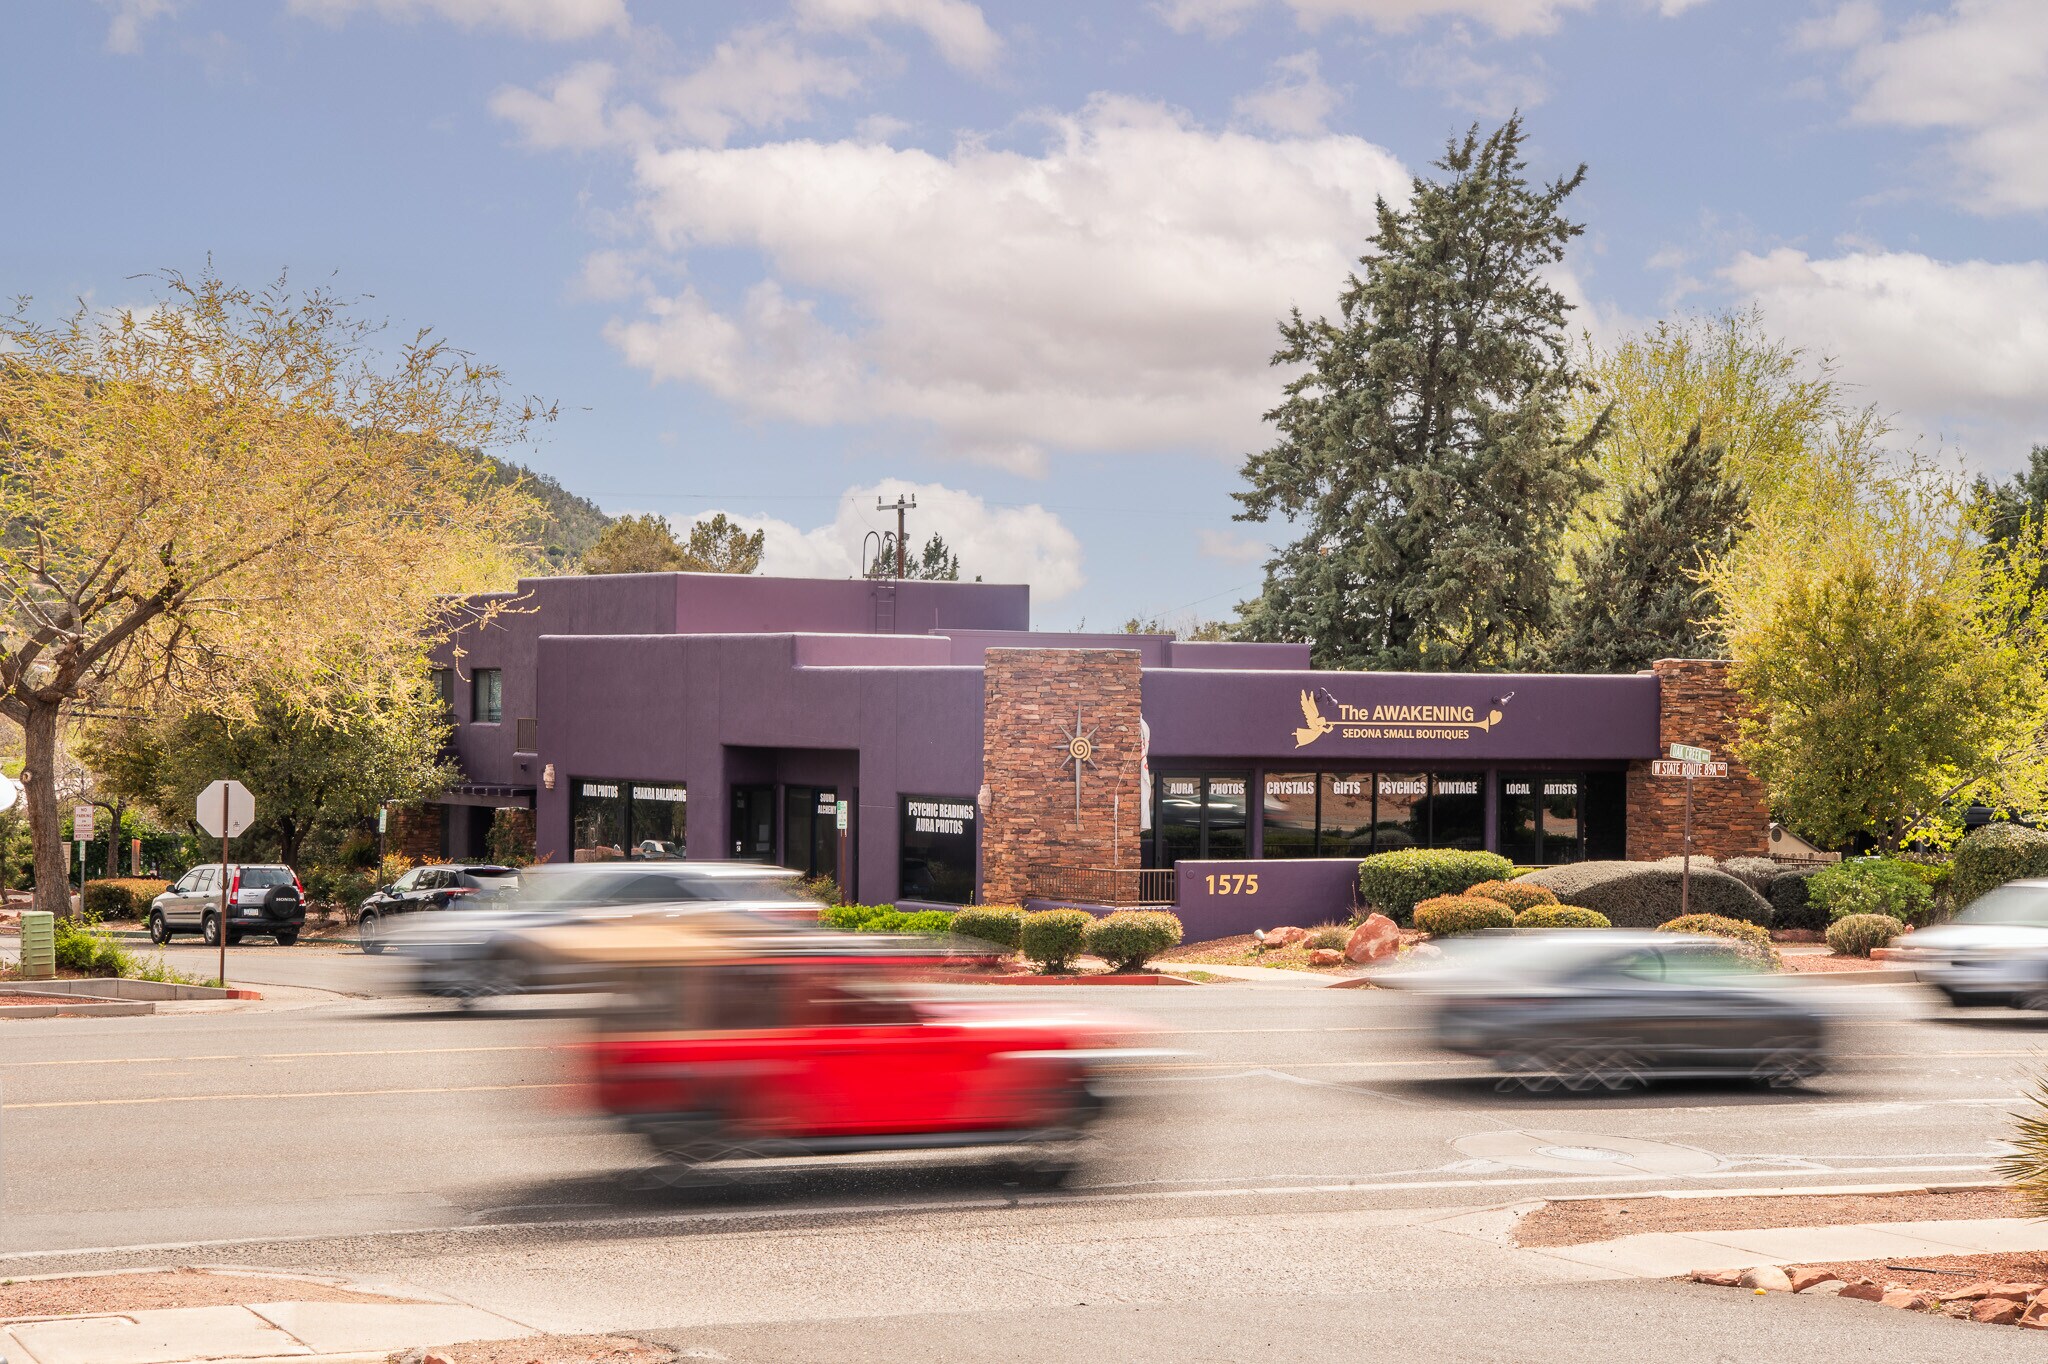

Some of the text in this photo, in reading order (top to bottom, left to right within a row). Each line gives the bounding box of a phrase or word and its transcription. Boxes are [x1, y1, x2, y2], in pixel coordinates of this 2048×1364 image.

[1338, 704, 1474, 722] The AWAKENING
[1342, 729, 1469, 740] SEDONA SMALL BOUTIQUES
[1672, 745, 1684, 758] OAK
[1685, 747, 1702, 761] CREEK
[1654, 762, 1660, 774] W
[1662, 763, 1680, 775] STATE
[1682, 763, 1702, 775] ROUTE
[1704, 764, 1717, 775] 89A
[582, 784, 619, 798] AURA PHOTOS
[633, 786, 687, 802] CHAKRA BALANCING
[1170, 783, 1245, 795] AURA PHOTOS
[1266, 781, 1314, 795] CRYSTALS
[1333, 781, 1361, 795] GIFTS
[1379, 781, 1427, 795] PSYCHICS
[1438, 781, 1478, 795] VINTAGE
[1506, 783, 1578, 795] LOCAL ARTISTS
[820, 793, 835, 803] SOUND
[908, 801, 974, 820] PSYCHIC READINGS
[915, 817, 963, 835] AURA PHOTOS
[1205, 874, 1259, 895] 1575
